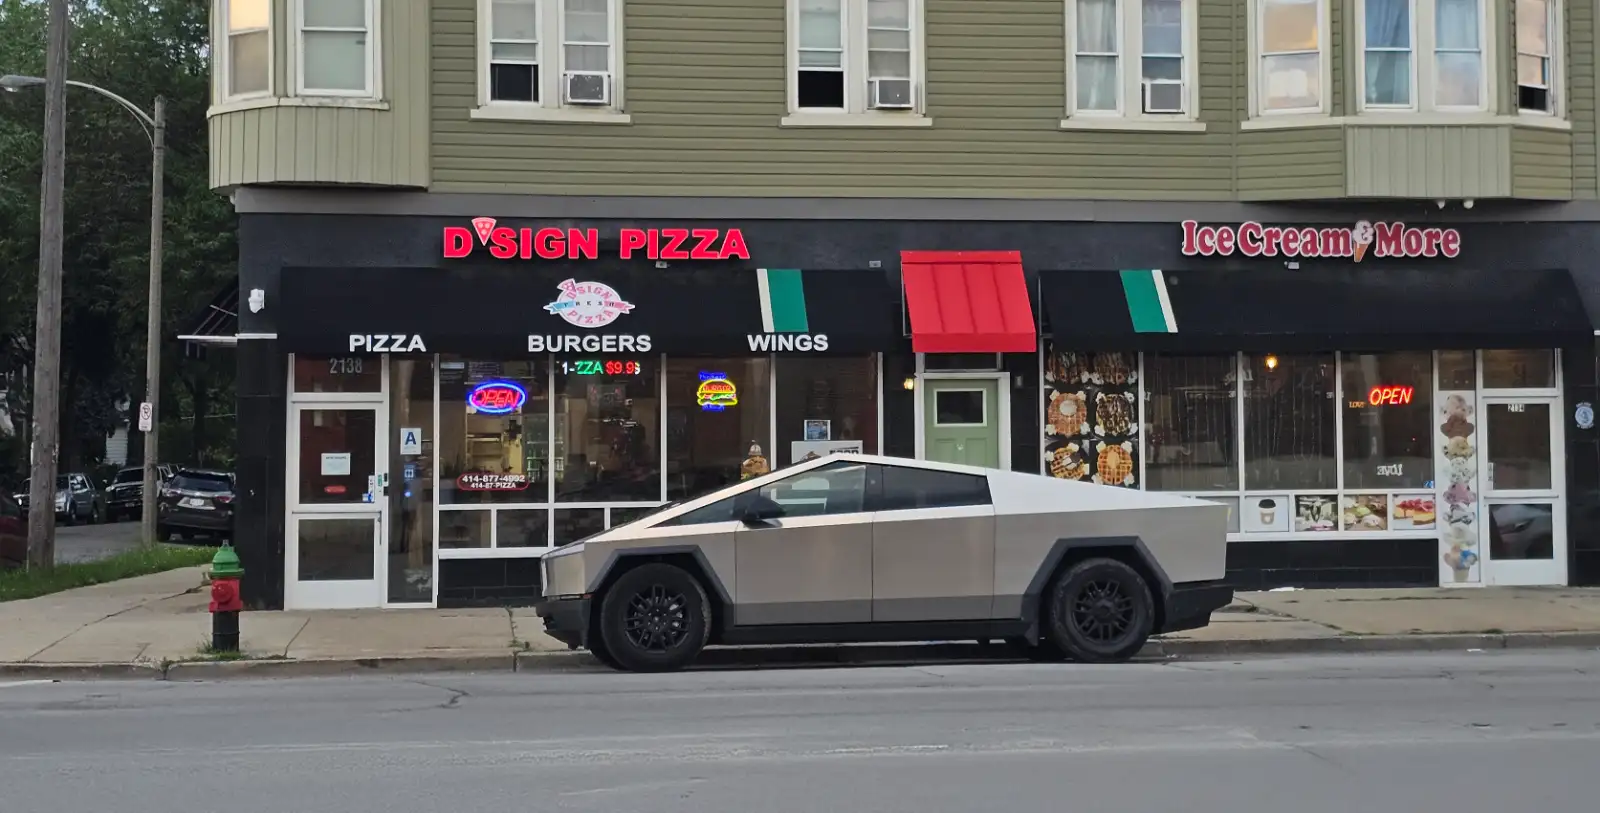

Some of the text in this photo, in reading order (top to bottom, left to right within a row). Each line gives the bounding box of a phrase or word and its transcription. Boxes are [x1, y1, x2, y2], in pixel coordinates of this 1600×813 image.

[620, 228, 750, 260] PIZZA
[1181, 219, 1235, 257] Ice
[1238, 220, 1353, 258] Cream
[1374, 221, 1461, 258] More
[567, 309, 614, 325] PIZZA
[349, 334, 427, 352] PIZZA
[527, 334, 652, 353] BURGERS
[747, 334, 829, 352] WINGS
[329, 357, 363, 374] 2138
[473, 388, 520, 409] OPEN
[1369, 387, 1413, 406] OPEN
[404, 431, 417, 446] A
